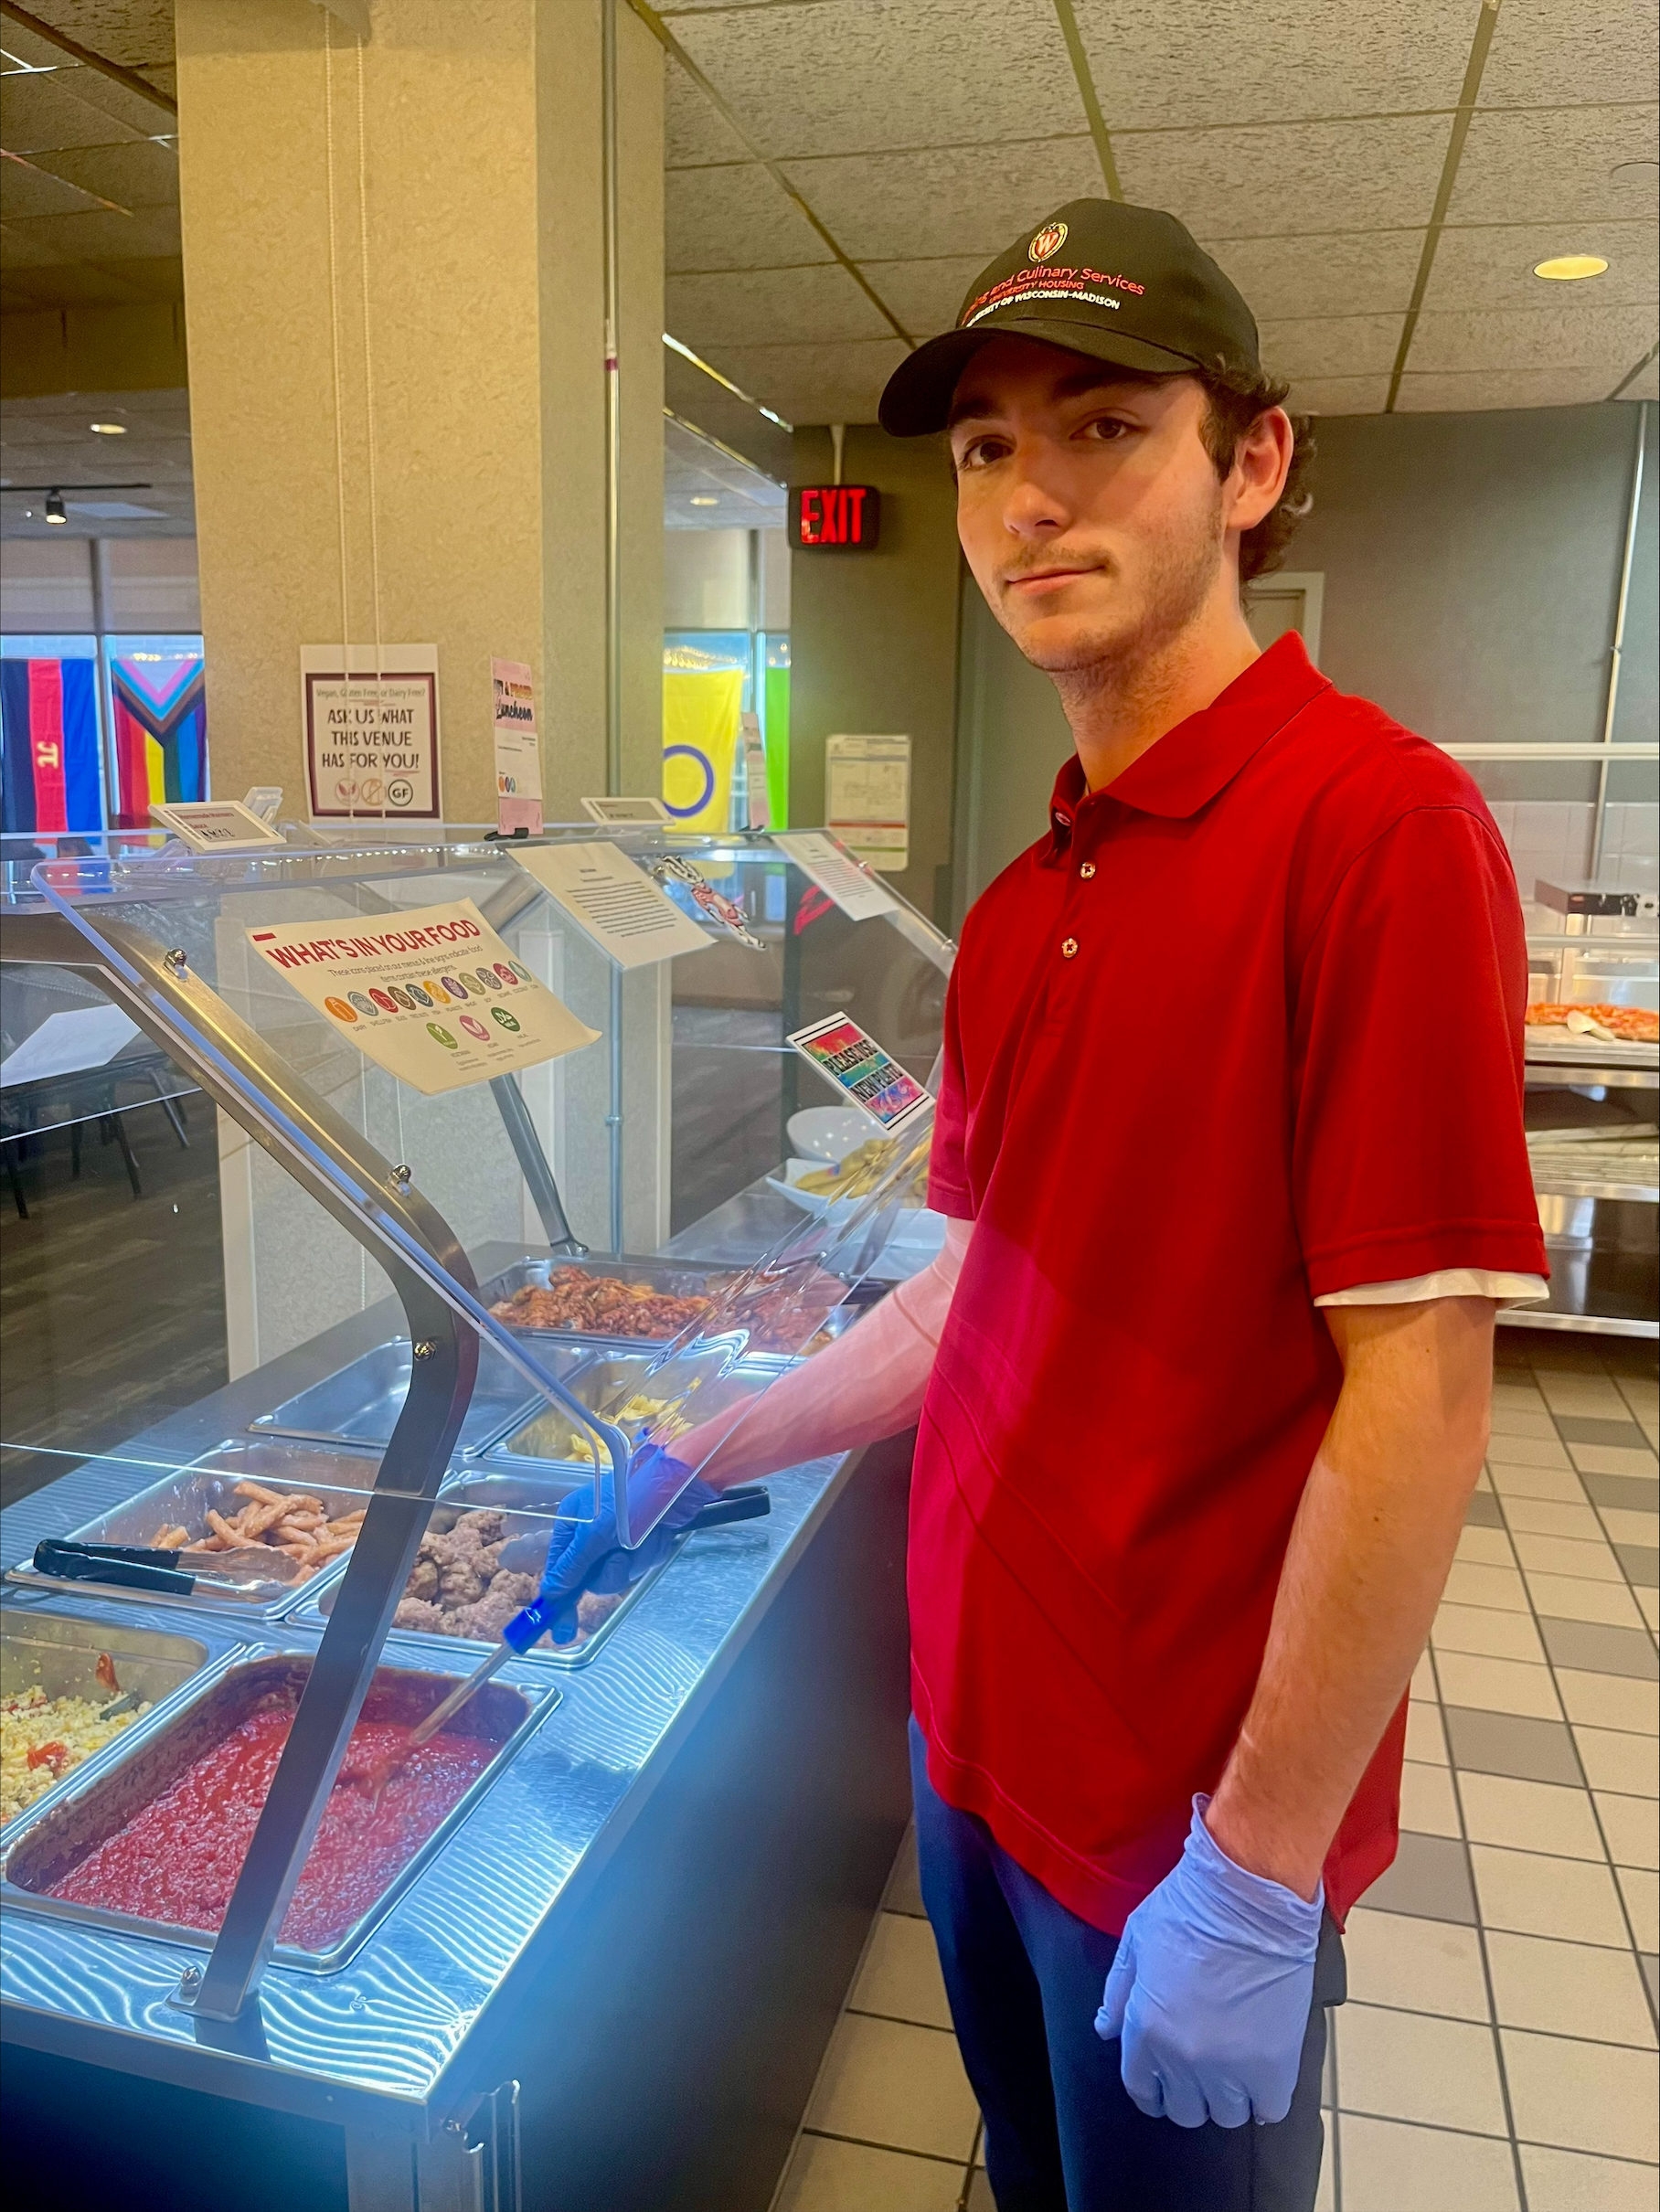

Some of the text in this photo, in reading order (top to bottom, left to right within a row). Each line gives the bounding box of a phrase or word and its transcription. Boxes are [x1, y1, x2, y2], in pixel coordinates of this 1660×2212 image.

[990, 265, 1145, 296] and Culinary Services
[1038, 280, 1085, 291] HOUSING
[801, 488, 867, 544] EXIT
[327, 708, 415, 725] ASK US WHAT
[331, 730, 413, 747] THIS VENUE
[322, 752, 420, 769] HAS FOR YOU!
[392, 788, 410, 799] GF
[265, 920, 481, 969] WHAT'S IN YOUR FOOD
[327, 968, 352, 977] These
[467, 944, 484, 953] food
[823, 1038, 878, 1076] PLEASE USE
[850, 1062, 903, 1102] NEW PLATE
